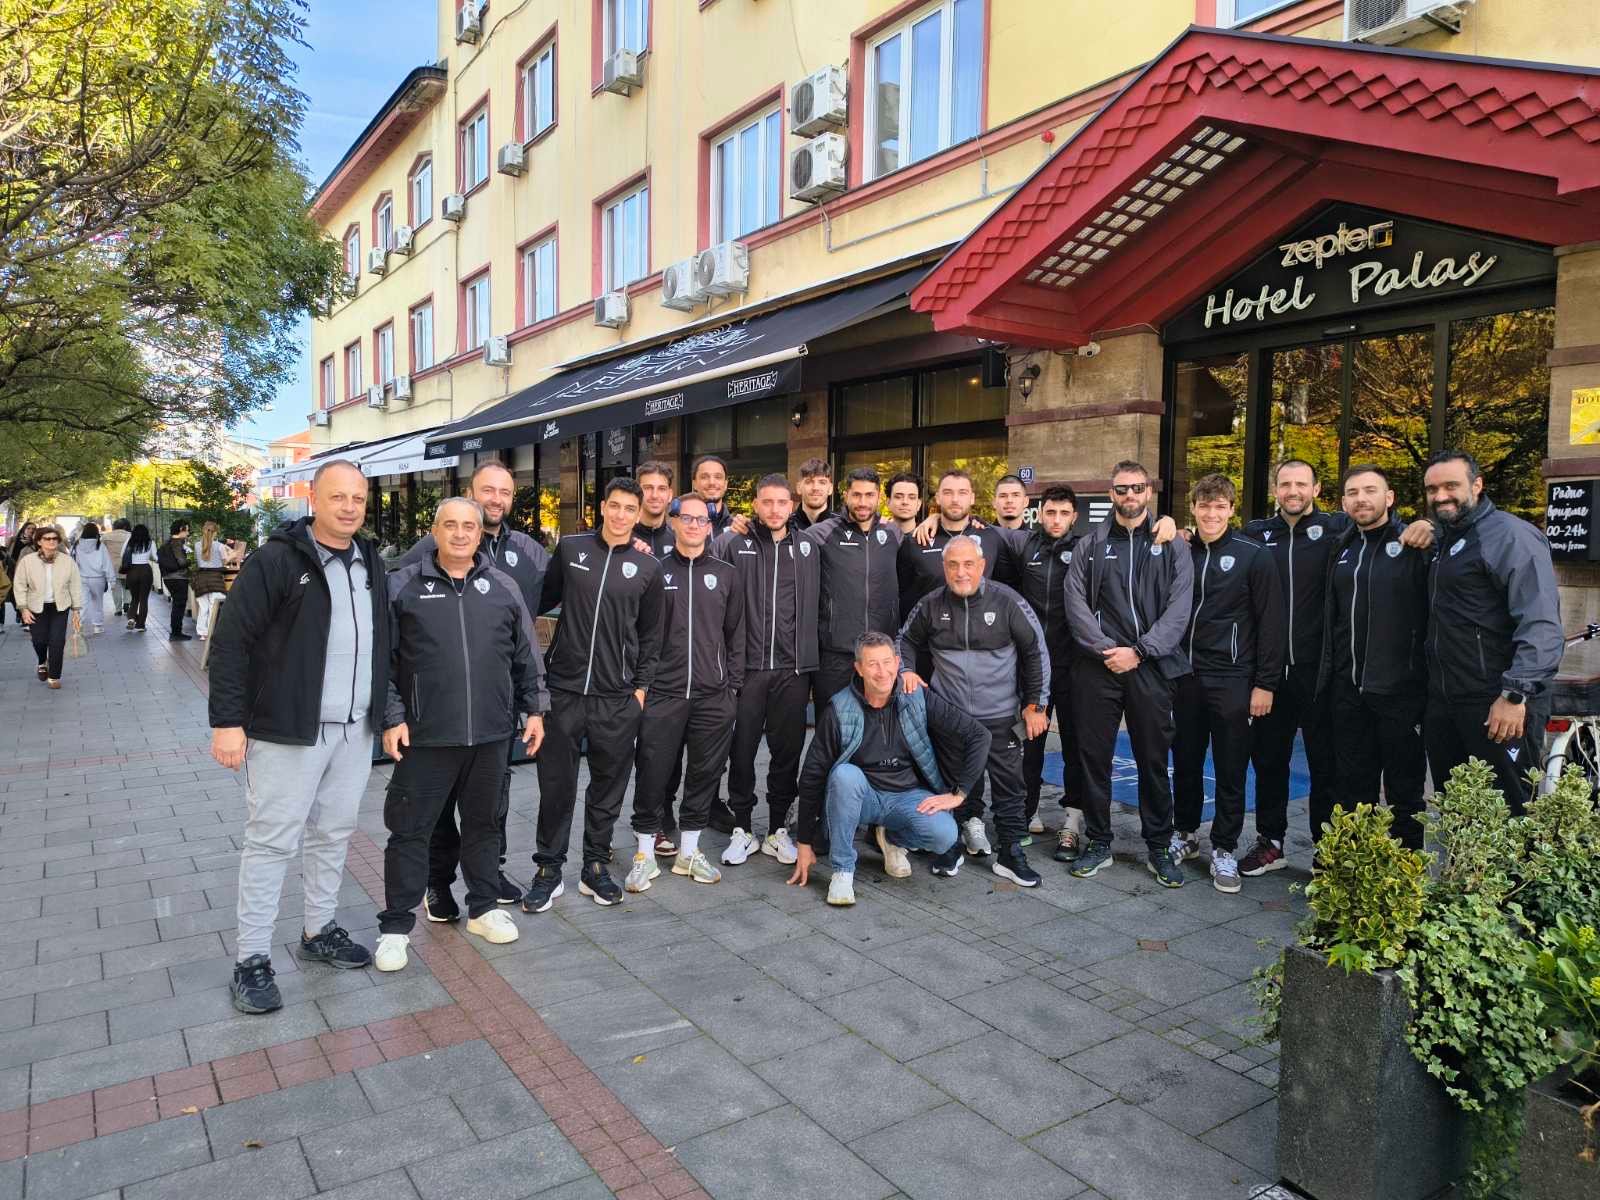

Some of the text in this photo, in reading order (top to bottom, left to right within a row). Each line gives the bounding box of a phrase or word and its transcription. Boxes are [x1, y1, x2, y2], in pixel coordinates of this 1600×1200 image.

[1278, 221, 1394, 269] zepter
[1204, 251, 1497, 328] Hotel Palas
[1020, 469, 1031, 479] 60
[1546, 524, 1588, 537] 00-24h
